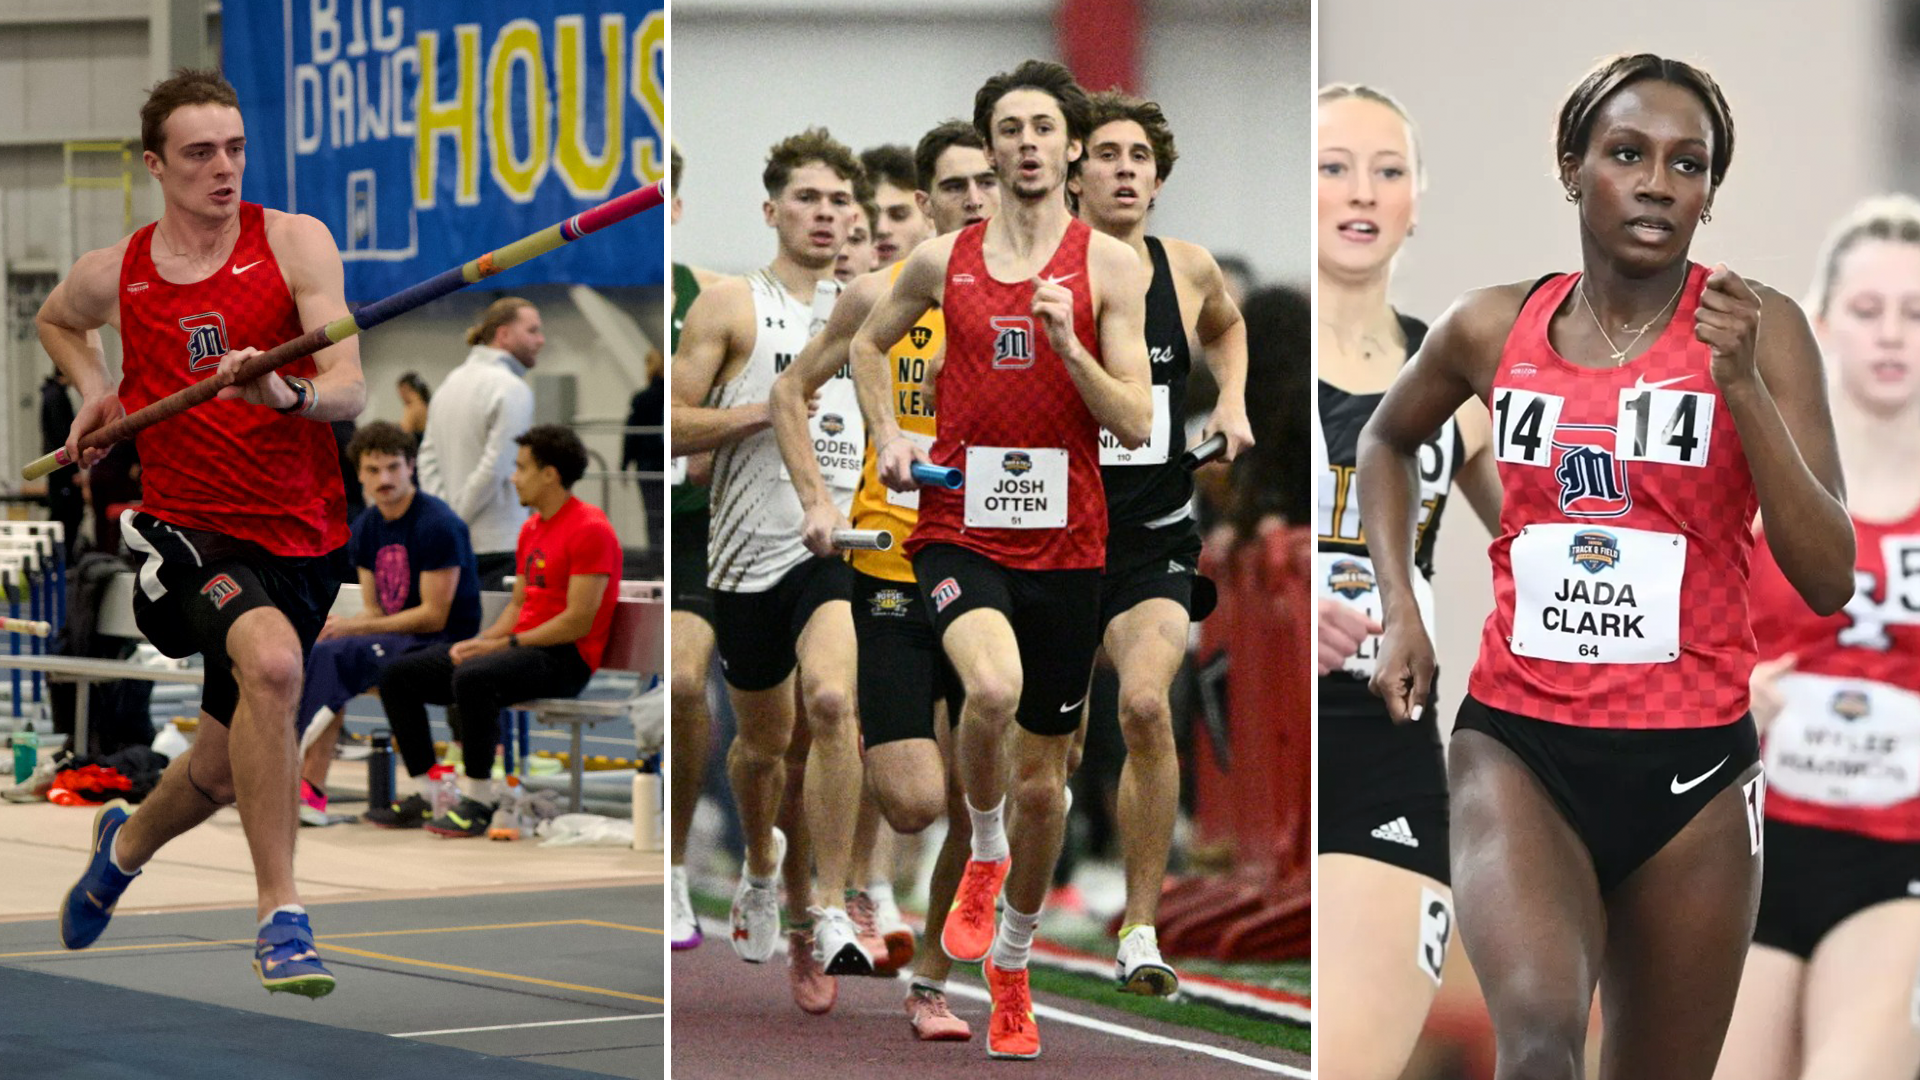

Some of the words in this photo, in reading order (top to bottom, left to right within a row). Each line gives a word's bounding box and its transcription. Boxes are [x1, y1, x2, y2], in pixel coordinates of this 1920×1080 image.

[310, 0, 404, 64] BIG
[1495, 390, 1546, 462] 14
[1624, 390, 1699, 462] 14
[811, 438, 857, 456] ODEN
[993, 479, 1044, 494] JOSH
[984, 496, 1047, 512] OTTEN
[1554, 578, 1637, 608] JADA
[1541, 606, 1645, 639] CLARK
[1578, 643, 1600, 658] 64
